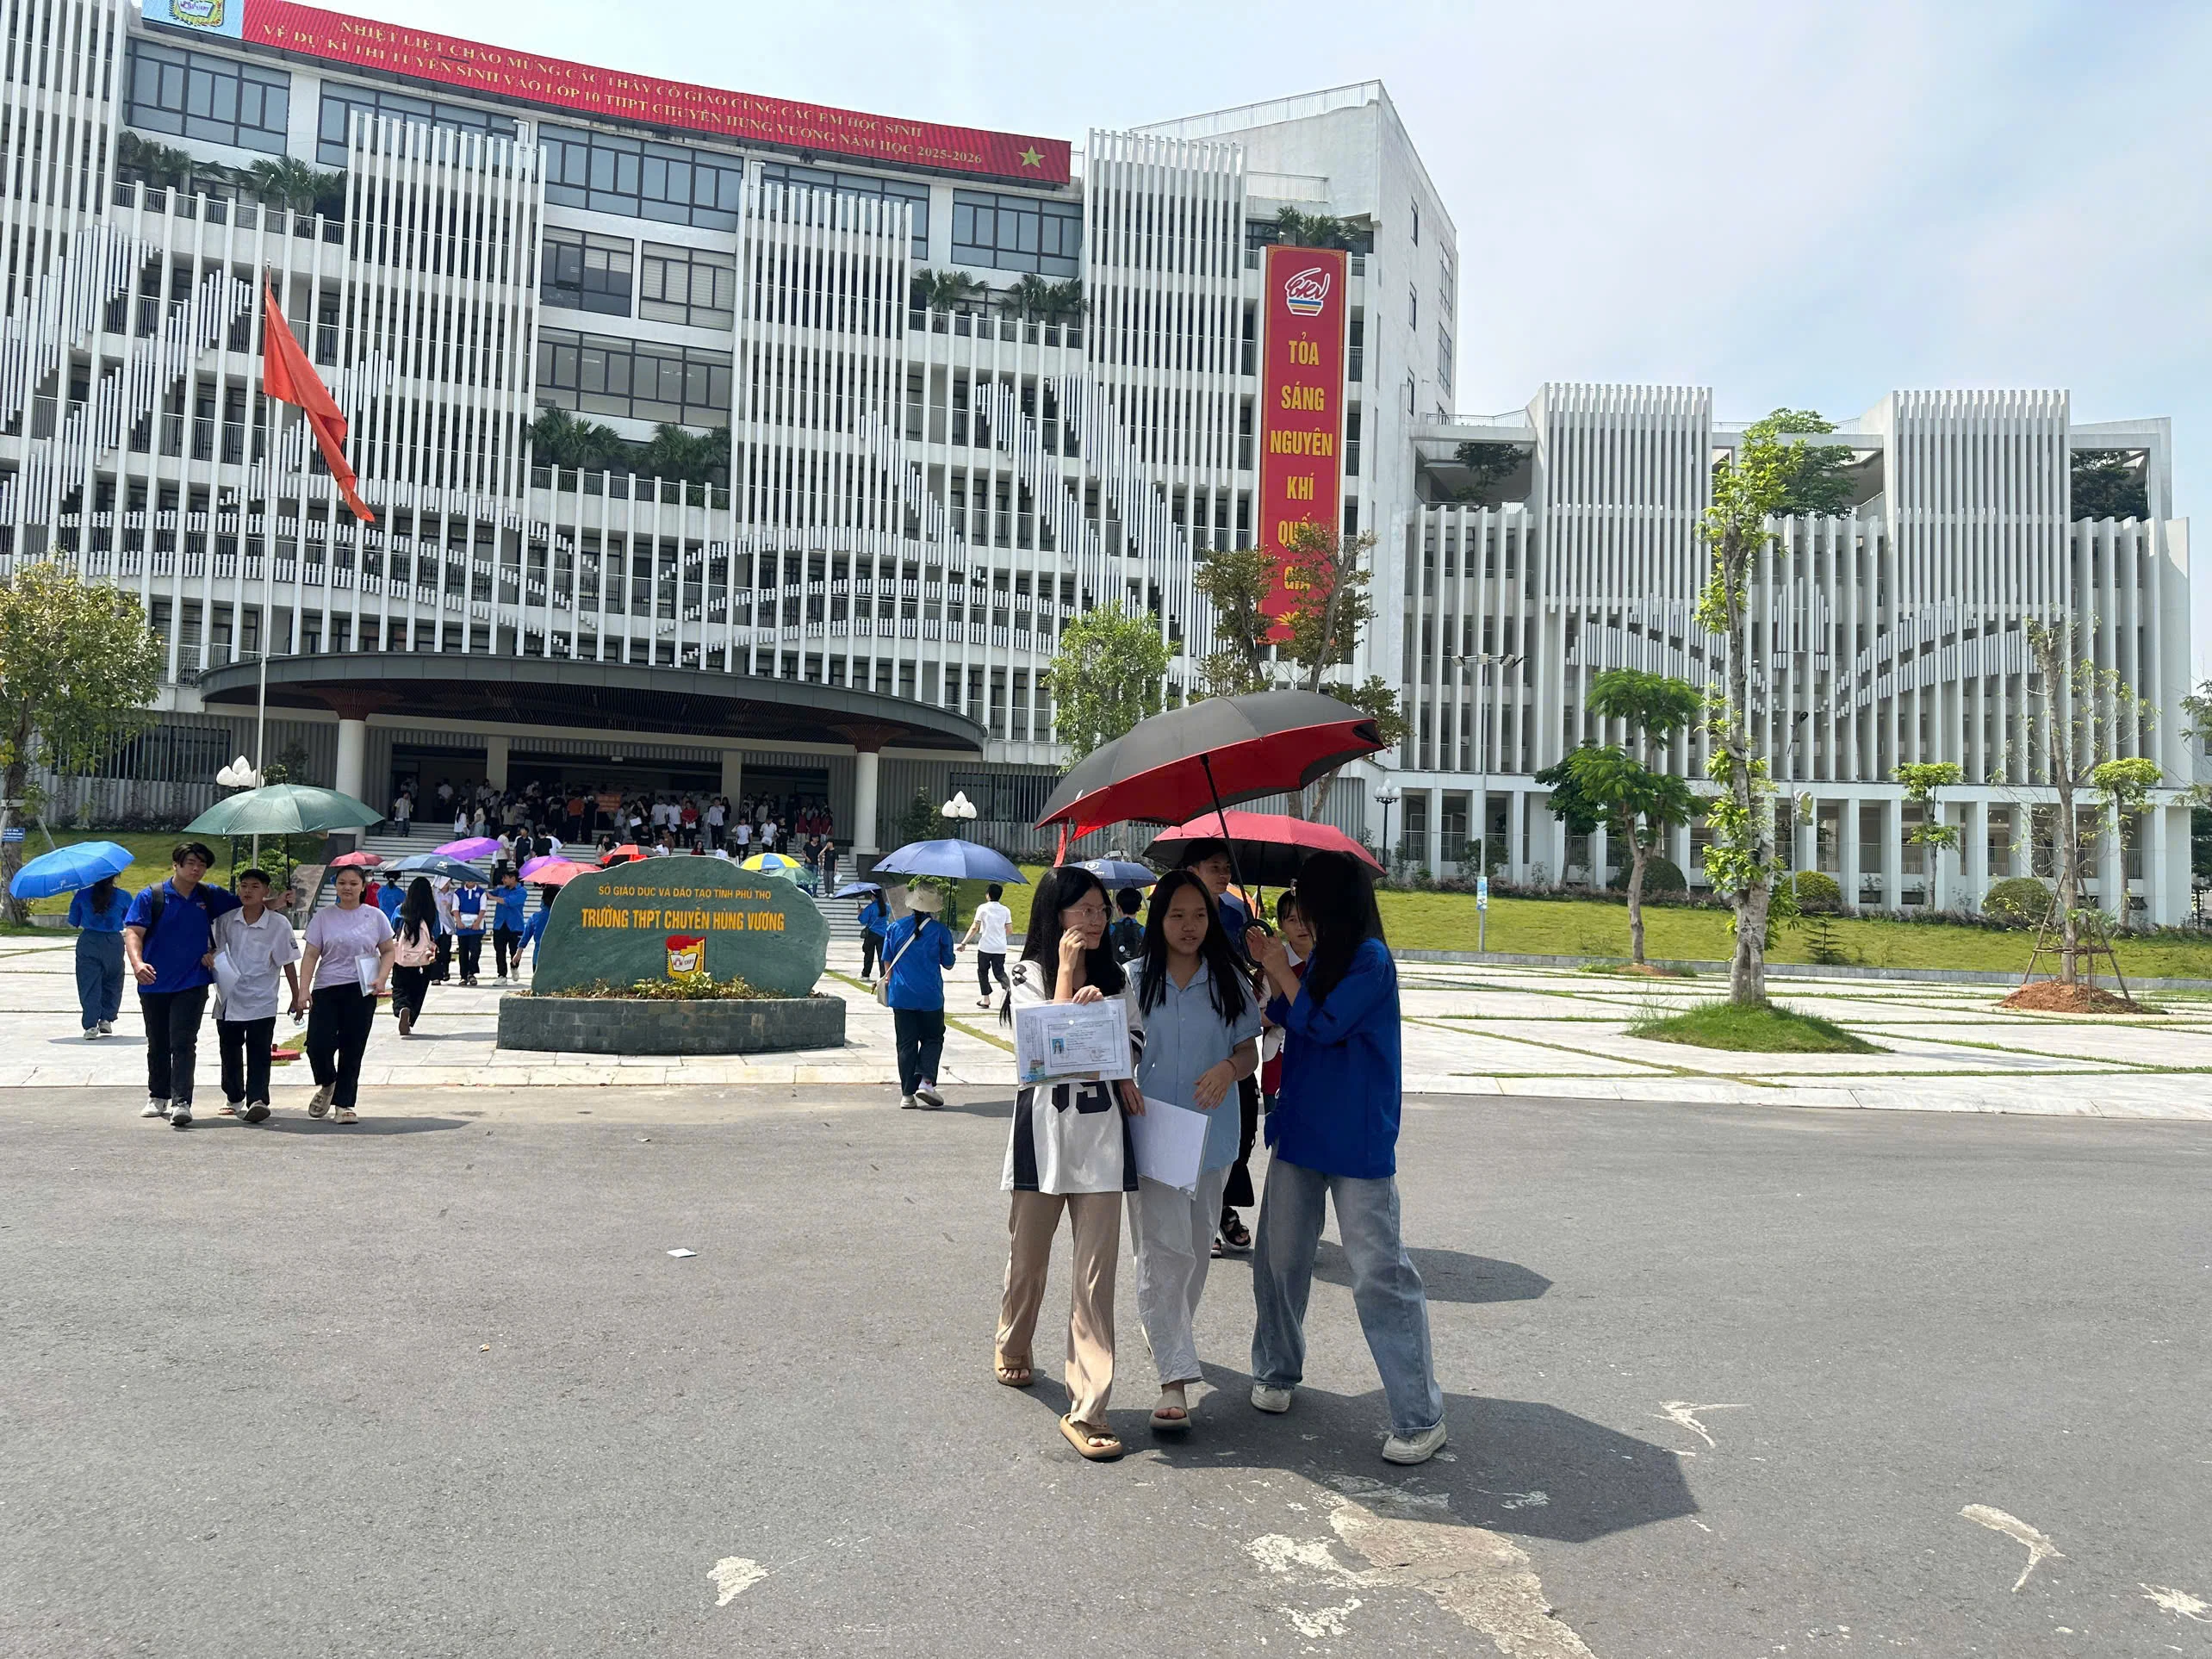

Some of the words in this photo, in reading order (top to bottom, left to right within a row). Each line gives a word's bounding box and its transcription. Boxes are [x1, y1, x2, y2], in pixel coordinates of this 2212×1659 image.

[449, 45, 501, 64] CHÀO
[565, 68, 601, 84] CÁC
[685, 90, 727, 106] GIÁO
[780, 106, 813, 121] CÁC
[819, 113, 843, 126] EM
[848, 116, 881, 132] HỌC
[885, 123, 923, 138] SINH
[457, 65, 500, 83] SINH
[504, 73, 542, 91] VÀO
[585, 90, 600, 103] 10
[605, 94, 649, 111] THPT
[879, 140, 913, 154] HỌC
[917, 146, 983, 165] 2025-2026
[1288, 331, 1320, 366] TỎA
[1281, 381, 1325, 411] SÁNG
[1270, 427, 1333, 457] NGUYÊN
[1286, 472, 1314, 500] KHÍ
[612, 884, 636, 896] GIÁO
[637, 886, 656, 900] DỤC
[735, 887, 752, 899] PHÚ
[755, 890, 772, 903] THỌ
[581, 904, 629, 929] TRƯỜNG
[632, 909, 662, 929] THPT
[664, 906, 710, 929] CHUYÊN
[712, 907, 744, 930] HÙNG
[747, 910, 786, 931] VƯƠNG
